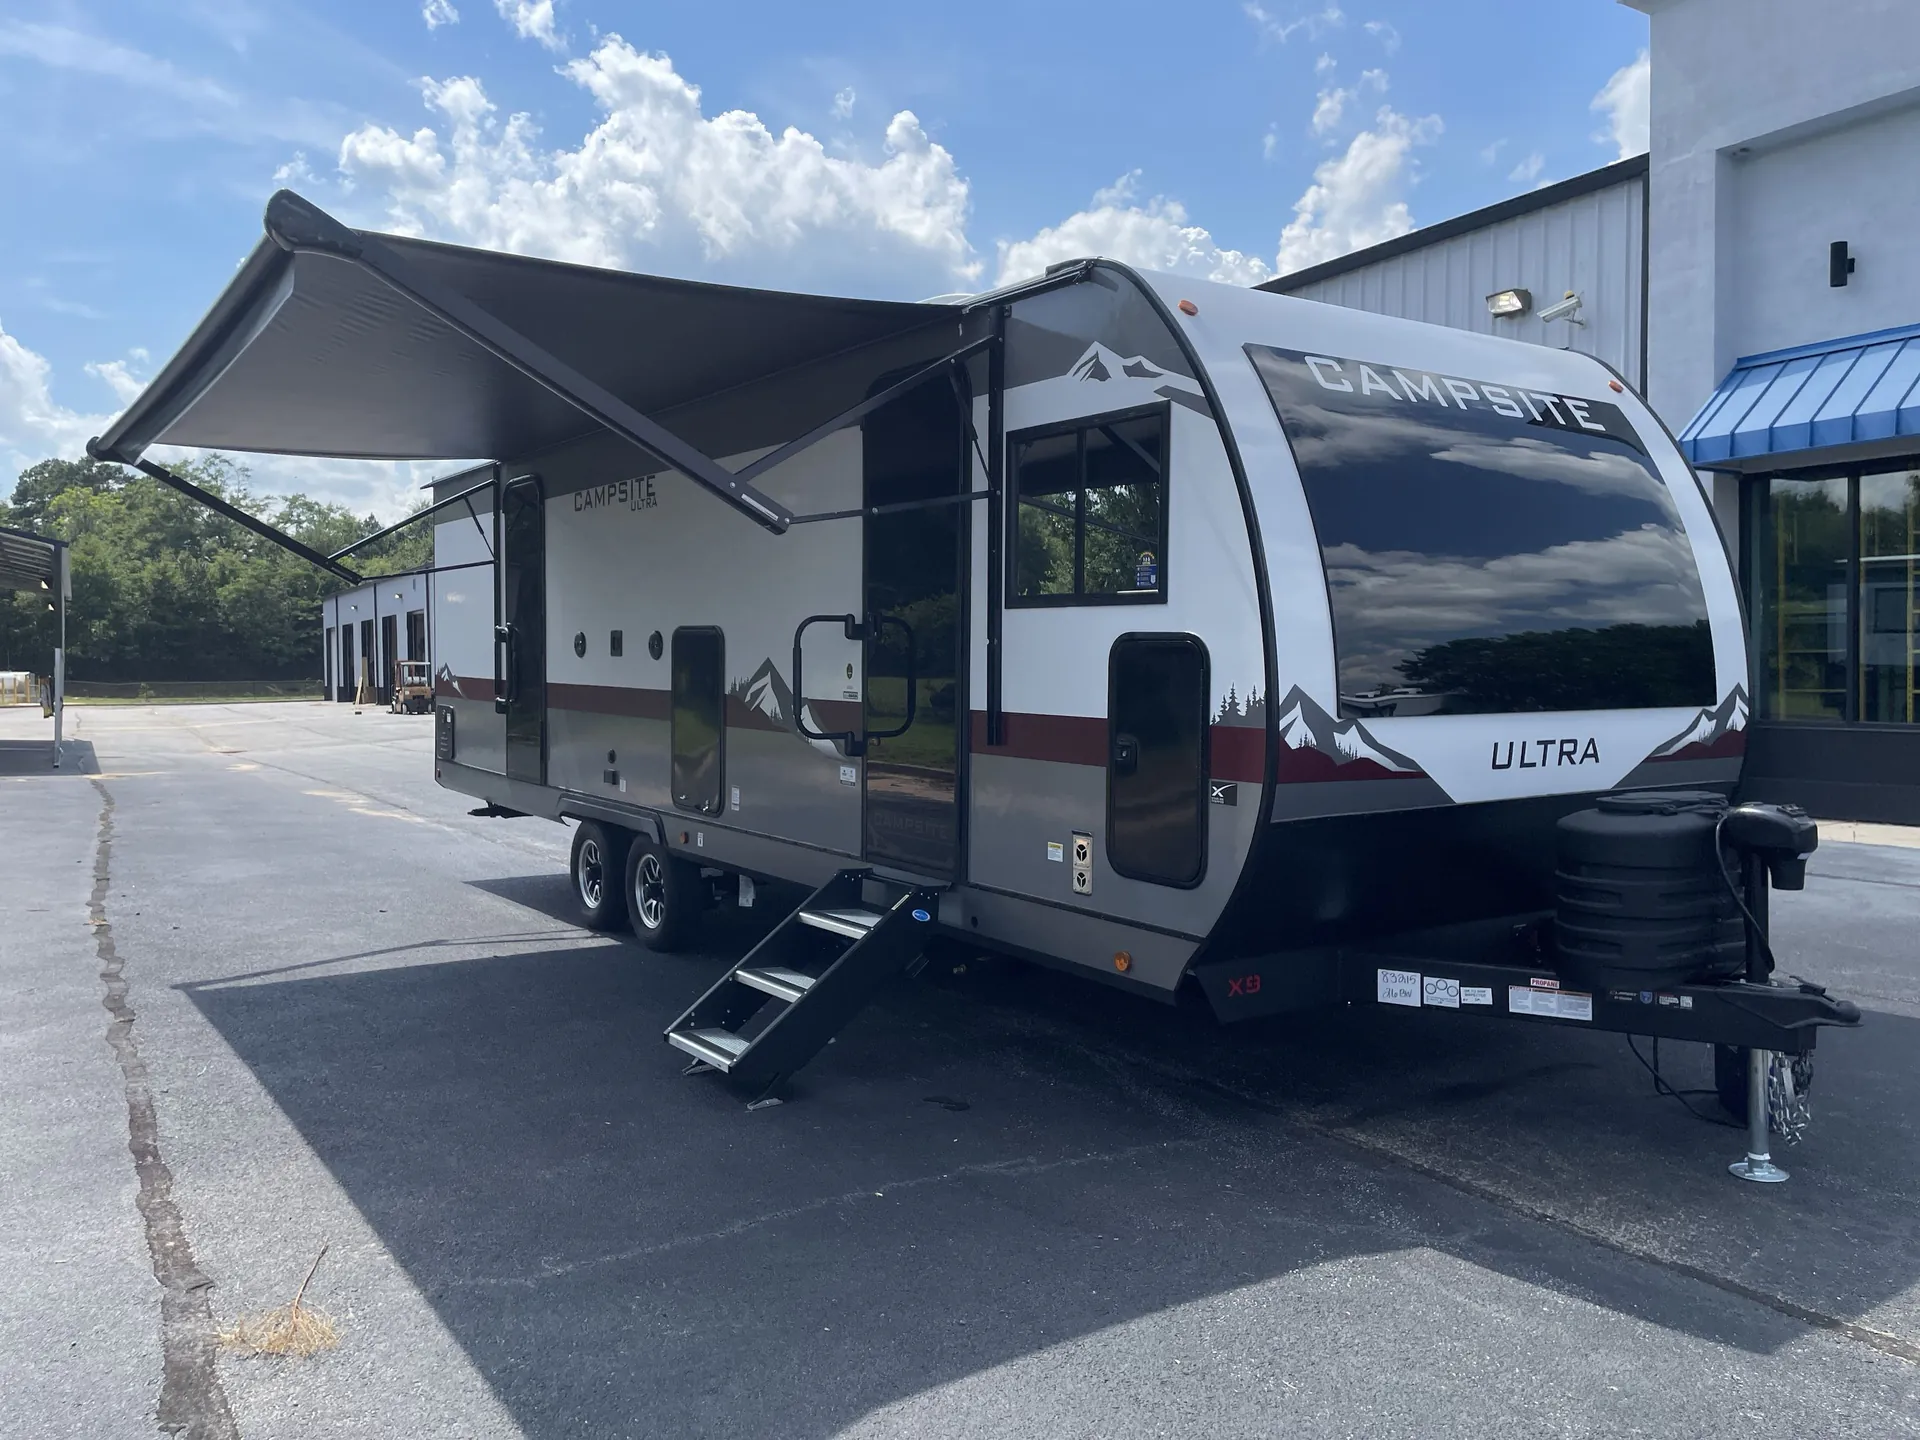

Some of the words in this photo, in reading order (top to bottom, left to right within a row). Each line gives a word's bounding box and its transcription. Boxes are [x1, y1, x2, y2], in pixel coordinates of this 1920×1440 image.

[1304, 355, 1606, 431] CAMPSITE
[574, 475, 656, 512] CAMPSITE
[630, 498, 658, 512] ULTRA
[1492, 738, 1600, 770] ULTRA
[1531, 979, 1559, 988] PROPANE
